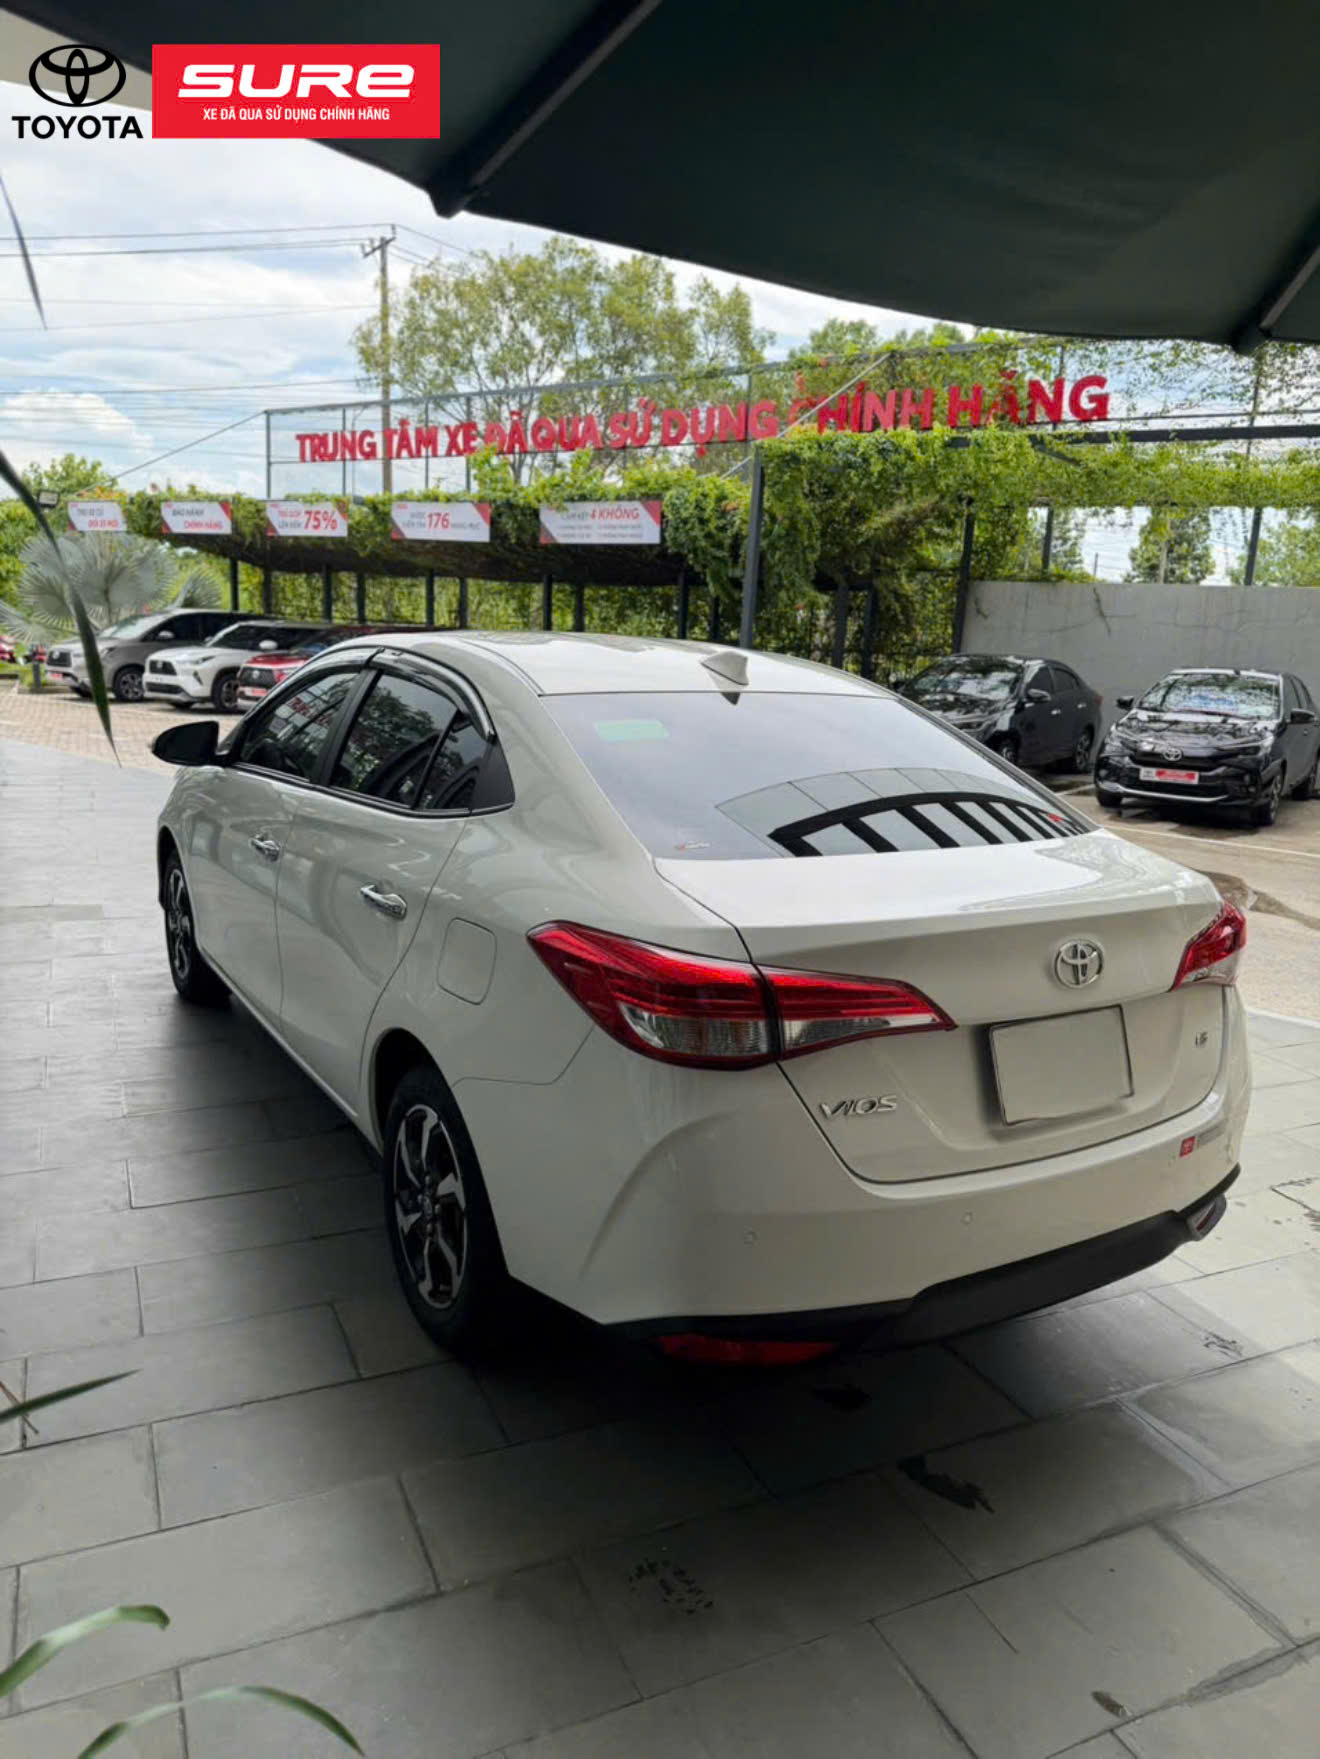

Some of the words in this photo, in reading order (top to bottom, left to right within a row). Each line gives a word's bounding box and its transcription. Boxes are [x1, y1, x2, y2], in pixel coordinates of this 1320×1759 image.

[296, 430, 376, 463] TRUNG
[382, 418, 438, 459] TÂM
[445, 421, 478, 456] XE
[530, 413, 600, 453] QUA
[609, 397, 657, 448] SỬ
[662, 399, 779, 457] DỤNG
[303, 509, 338, 531] 75%
[427, 511, 450, 530] 176
[819, 1094, 898, 1120] VIOS
